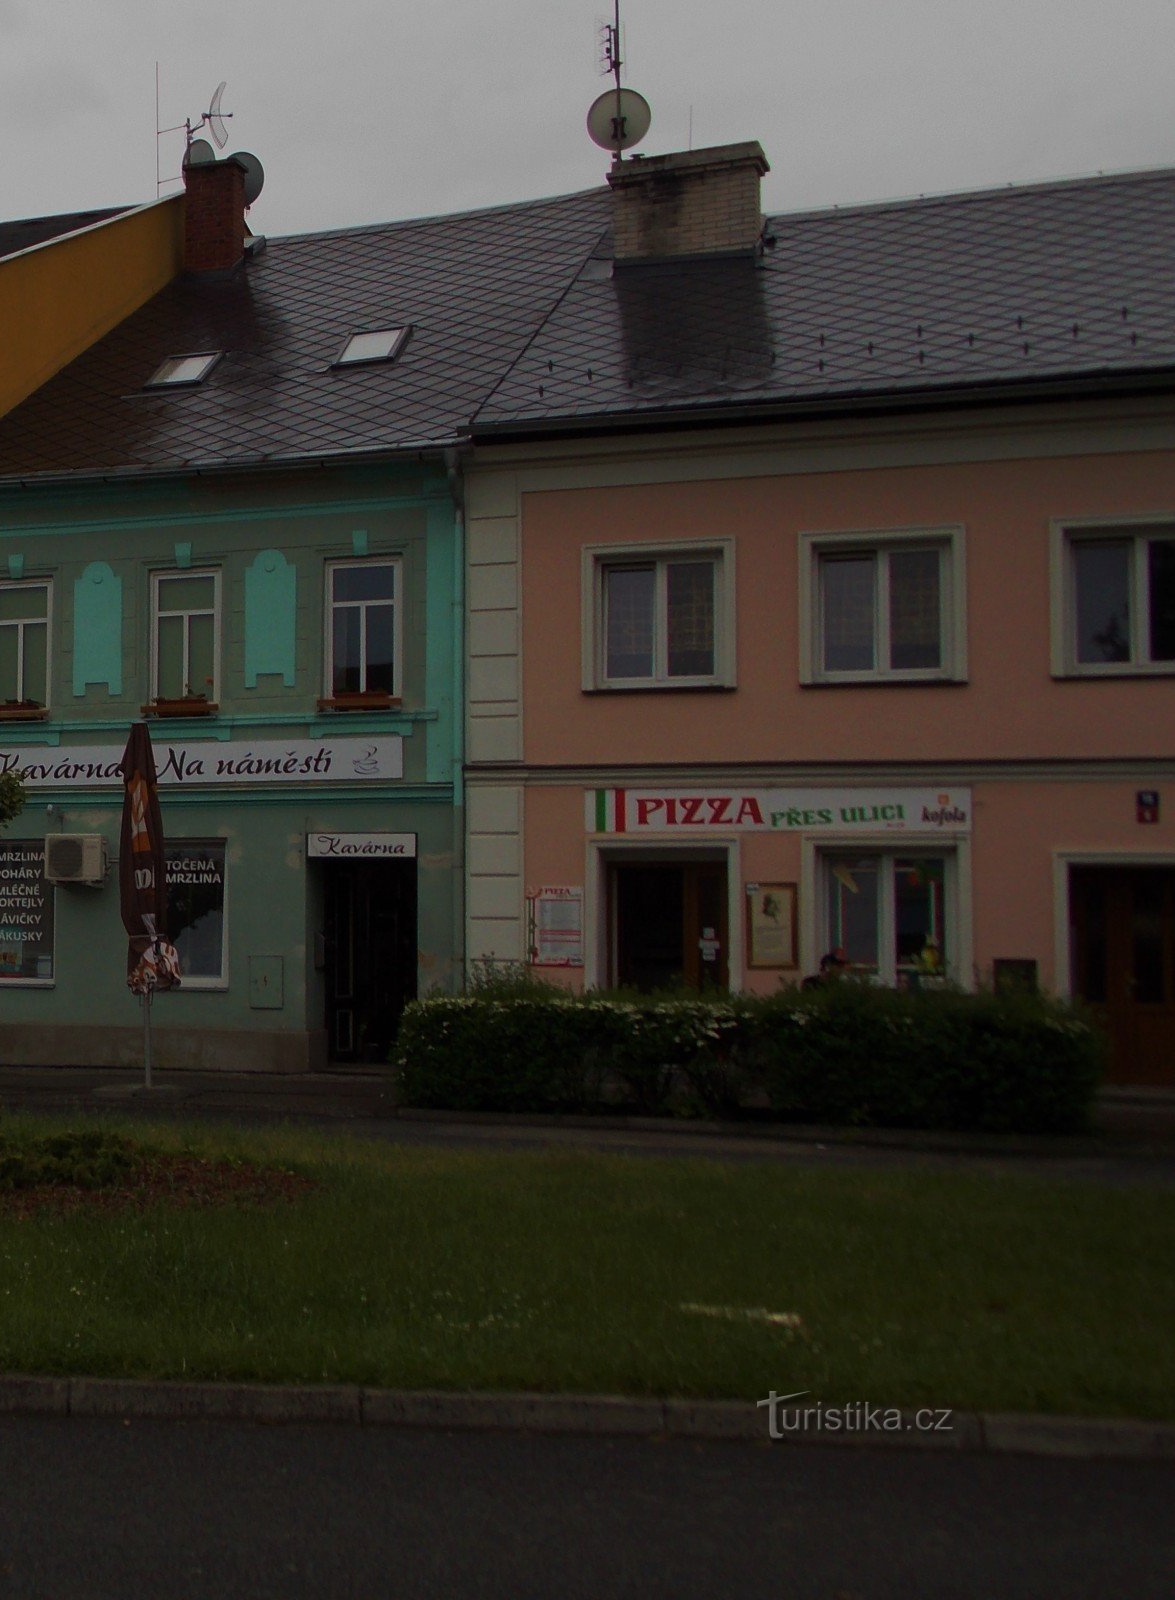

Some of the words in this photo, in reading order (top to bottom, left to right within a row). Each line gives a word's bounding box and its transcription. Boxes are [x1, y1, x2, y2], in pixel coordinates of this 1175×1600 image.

[156, 747, 204, 781] Na
[216, 747, 332, 776] náměstí
[636, 797, 765, 825] PIZZA
[770, 808, 832, 827] PŘES
[840, 804, 905, 822] ULICI
[318, 835, 406, 856] Kavárna
[165, 858, 215, 872] TOČENÁ
[164, 872, 222, 884] MRZLINA
